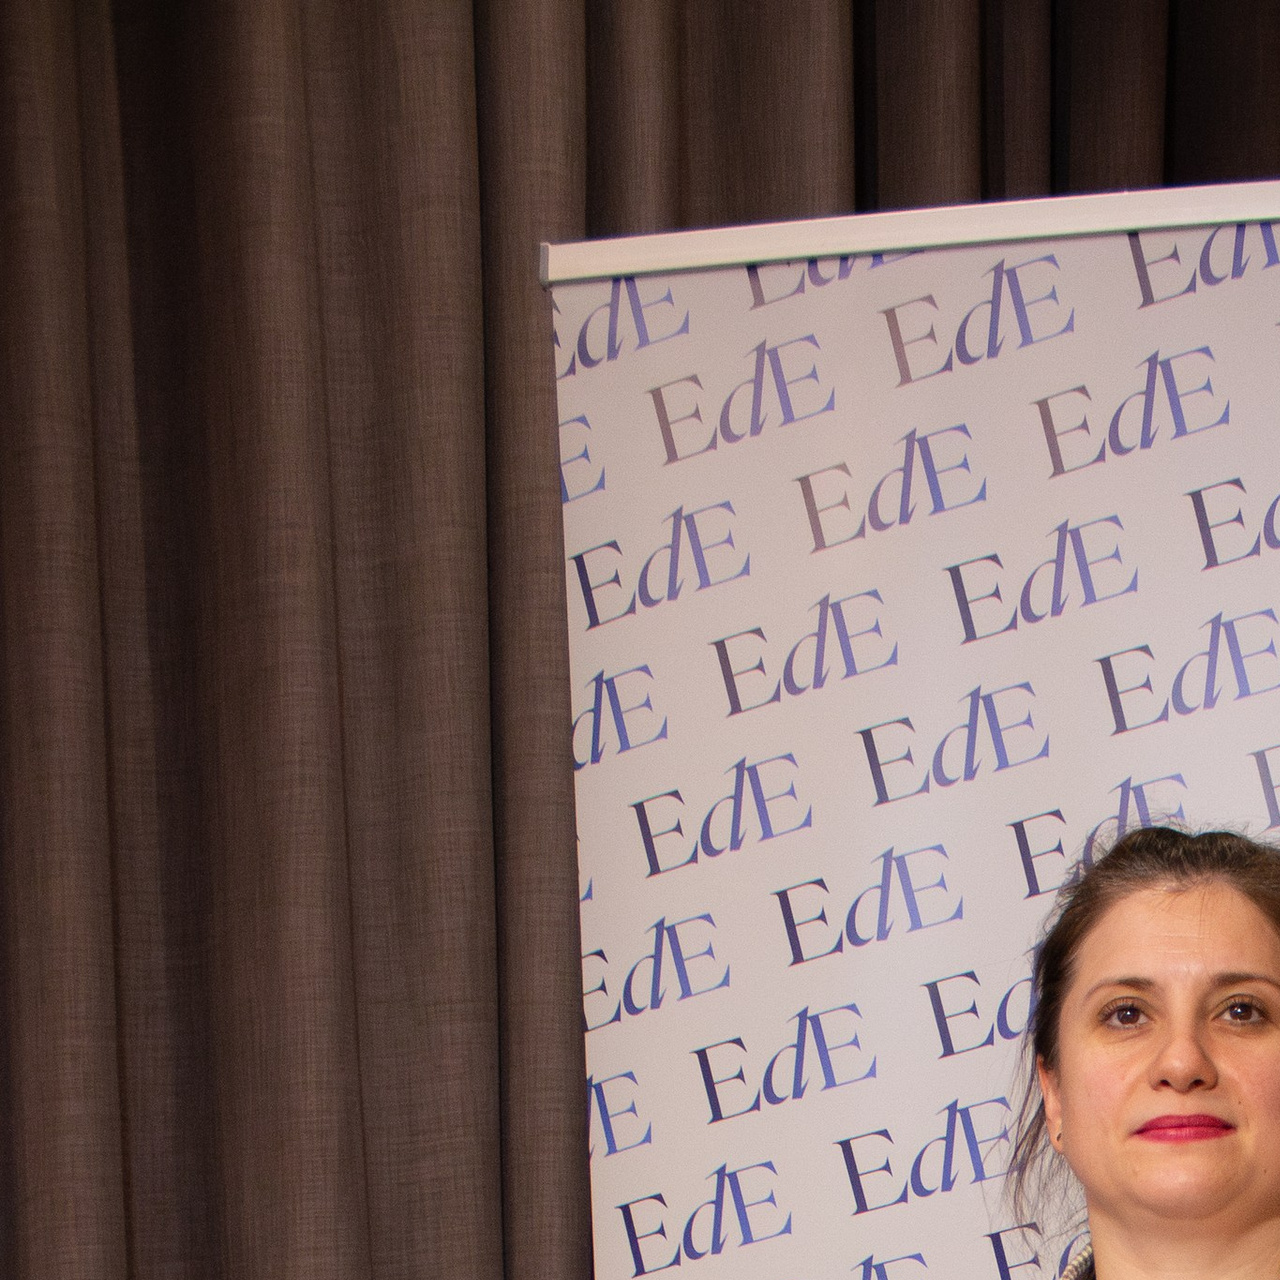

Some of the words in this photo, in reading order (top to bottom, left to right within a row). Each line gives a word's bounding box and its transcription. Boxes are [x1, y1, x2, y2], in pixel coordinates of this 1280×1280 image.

[552, 274, 690, 381] dE
[880, 253, 1075, 387] EdE
[647, 333, 835, 465] EdE
[1033, 345, 1230, 478] EdE
[794, 423, 987, 553] EdE
[568, 501, 751, 632] EdE
[943, 513, 1138, 644] EdE
[709, 588, 898, 717] EdE
[572, 664, 669, 772] dE
[855, 681, 1050, 807] EdE
[629, 751, 813, 878] EdE
[771, 843, 964, 966] EdE
[919, 938, 1040, 1060] Ed
[690, 1002, 877, 1124] EdE
[615, 1160, 792, 1278] EdE
